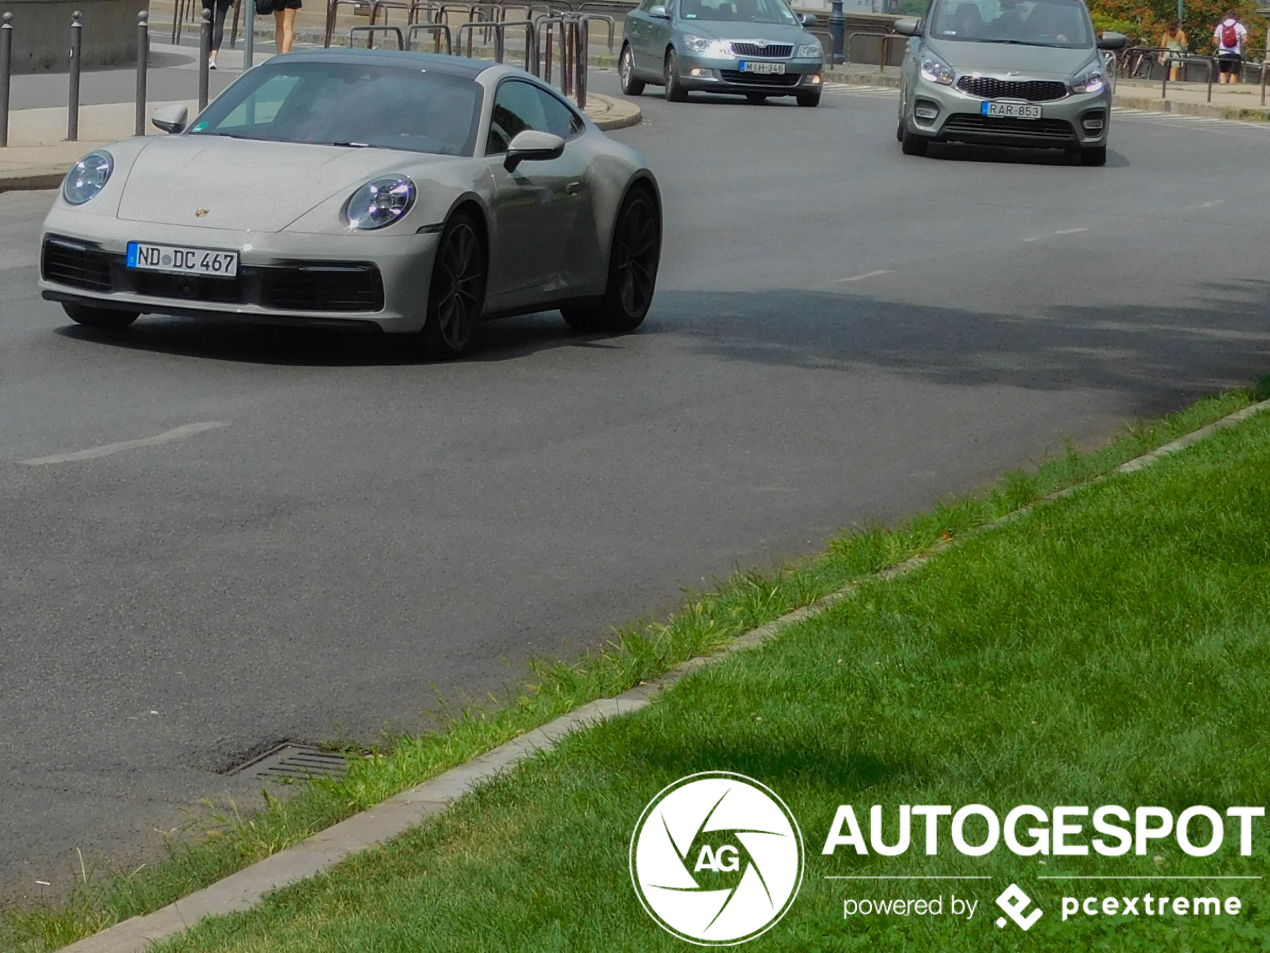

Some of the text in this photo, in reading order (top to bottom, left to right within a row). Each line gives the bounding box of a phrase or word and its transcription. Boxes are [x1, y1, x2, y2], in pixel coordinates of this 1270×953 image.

[746, 63, 784, 73] MIH-346
[990, 104, 1039, 117] RAR-853
[138, 246, 235, 273] ND DC 467
